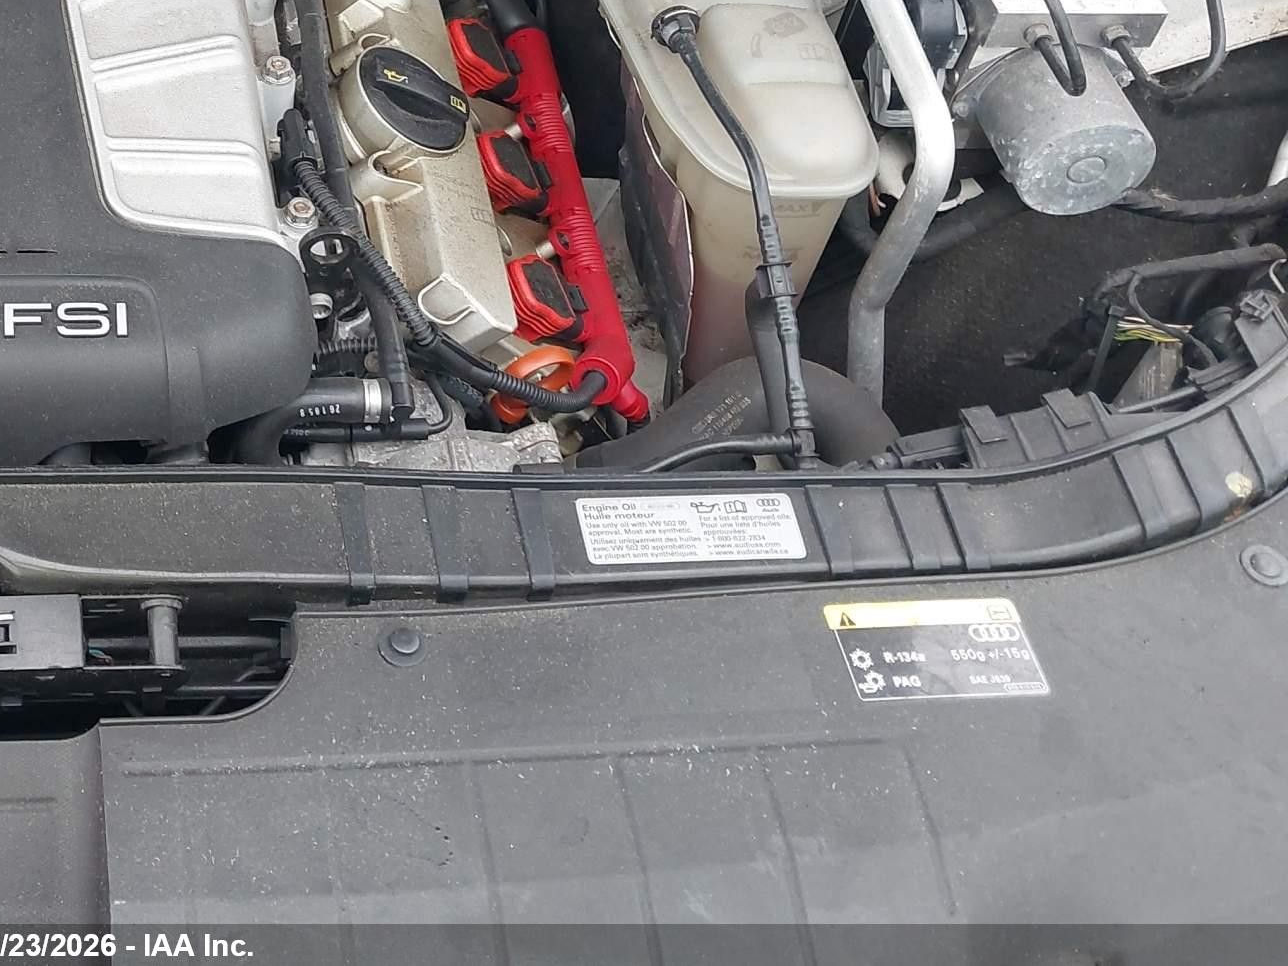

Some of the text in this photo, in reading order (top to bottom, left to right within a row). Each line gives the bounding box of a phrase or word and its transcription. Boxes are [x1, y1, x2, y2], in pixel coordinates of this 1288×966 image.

[582, 504, 619, 513] Engine
[622, 502, 637, 511] Oil
[584, 512, 611, 521] Huile
[602, 521, 618, 530] only
[883, 651, 927, 664] R-134a
[951, 648, 986, 662] 550g
[892, 675, 922, 688] PAG
